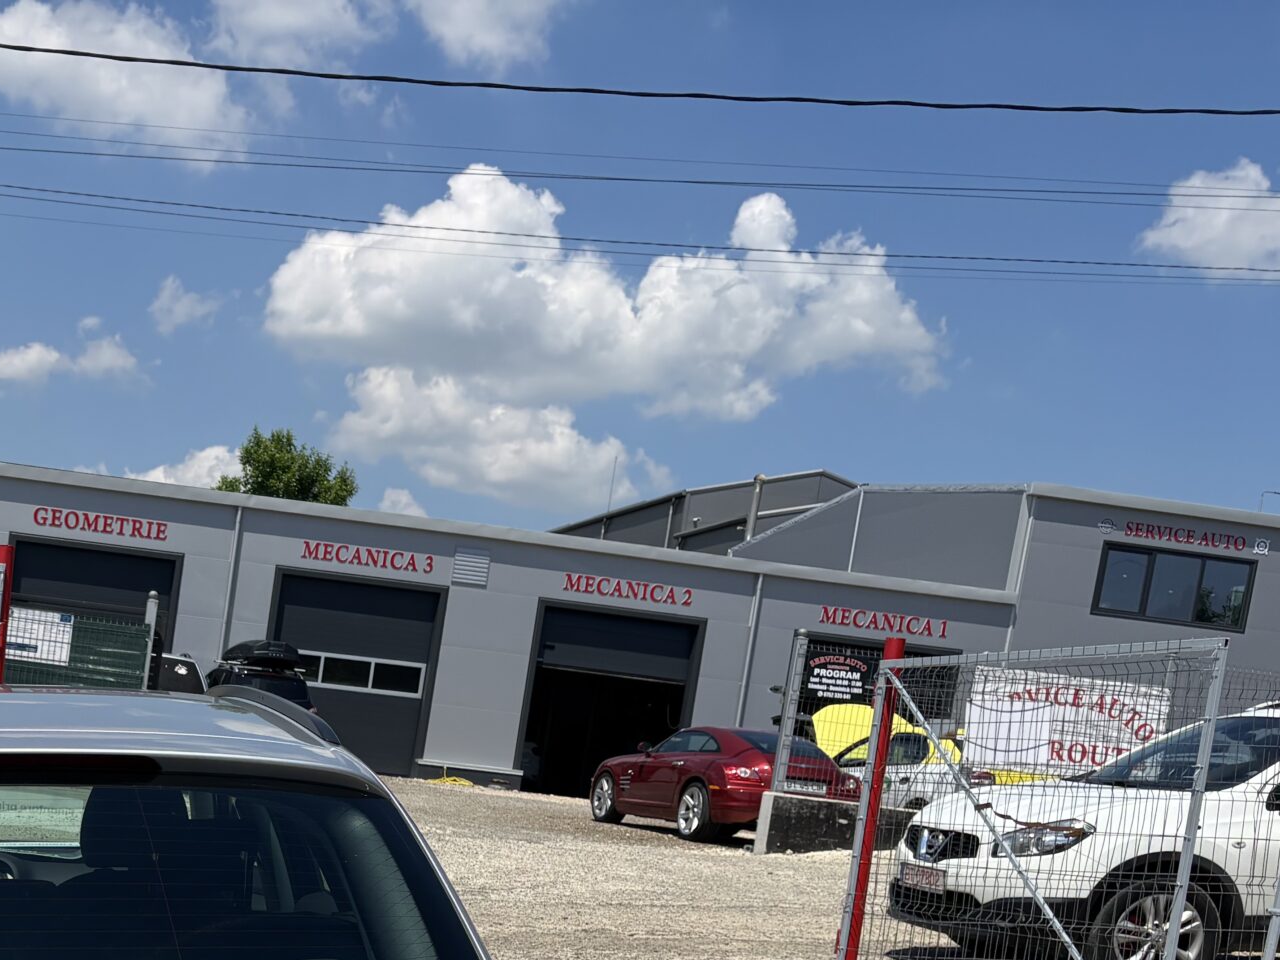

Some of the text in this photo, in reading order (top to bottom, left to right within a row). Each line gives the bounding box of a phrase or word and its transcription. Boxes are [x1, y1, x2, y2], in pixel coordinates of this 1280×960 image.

[33, 507, 168, 541] GEOMETRIE
[1124, 521, 1247, 551] SERVICE AUTO
[301, 541, 434, 574] MECANICA 3
[563, 573, 693, 607] MECANICA 2
[819, 606, 948, 638] MECANICA 1
[810, 656, 844, 667] SERVICE
[845, 658, 867, 671] AUTO
[814, 668, 860, 680] PROGRAM
[1091, 694, 1154, 741] AUTO
